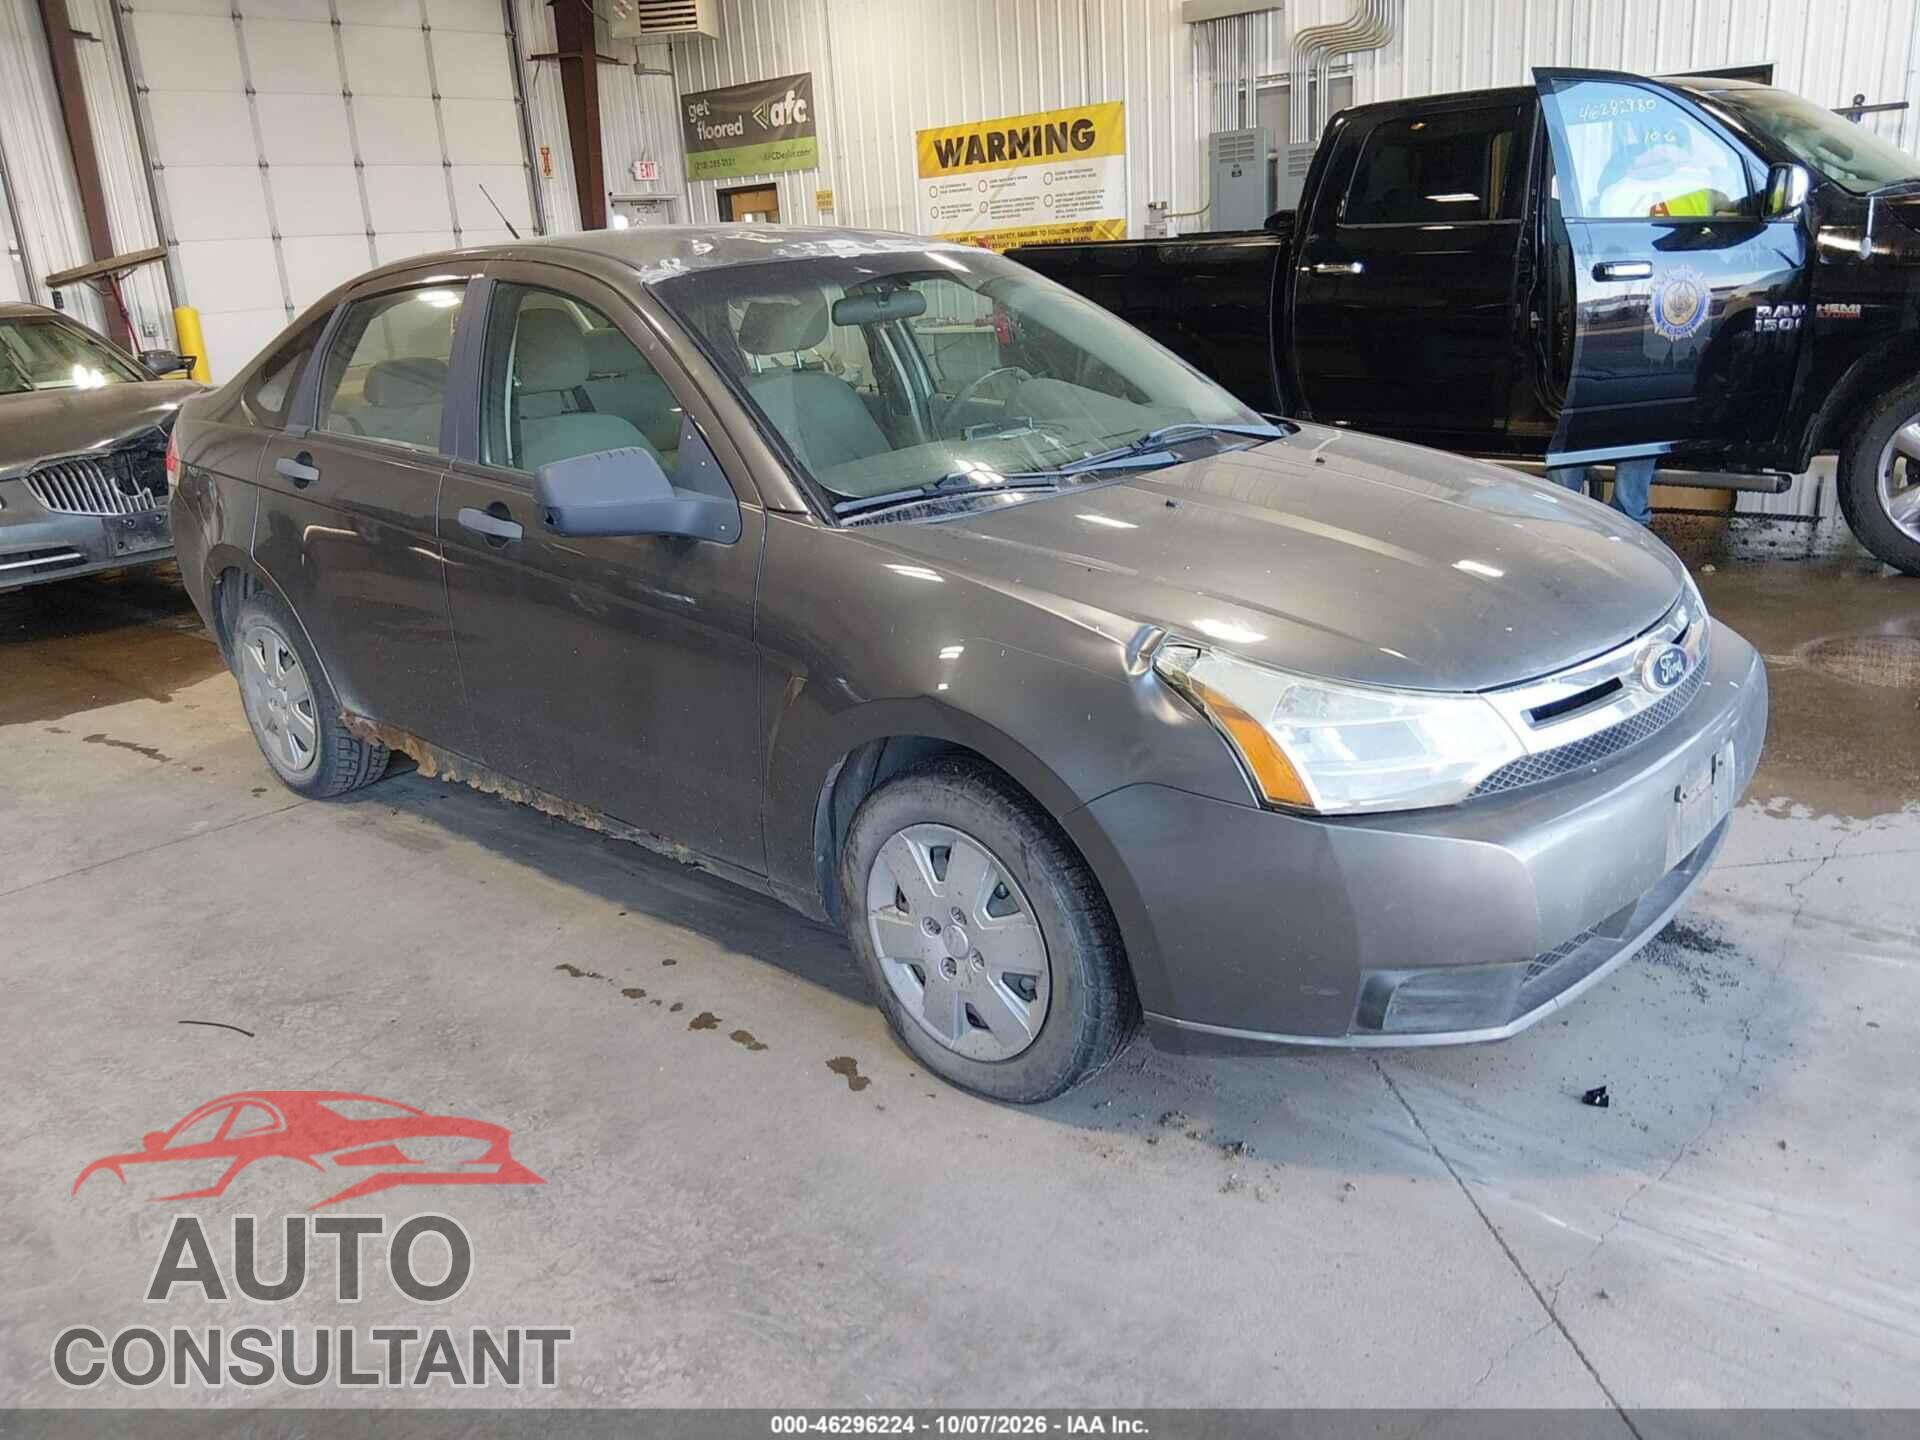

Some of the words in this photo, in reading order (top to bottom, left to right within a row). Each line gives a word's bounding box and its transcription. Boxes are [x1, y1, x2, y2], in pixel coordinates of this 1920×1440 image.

[688, 99, 711, 123] get
[770, 90, 808, 127] afc
[697, 115, 744, 141] floored
[933, 118, 1096, 169] WARNING
[640, 162, 654, 178] EXIT
[1816, 303, 1862, 314] HEMI
